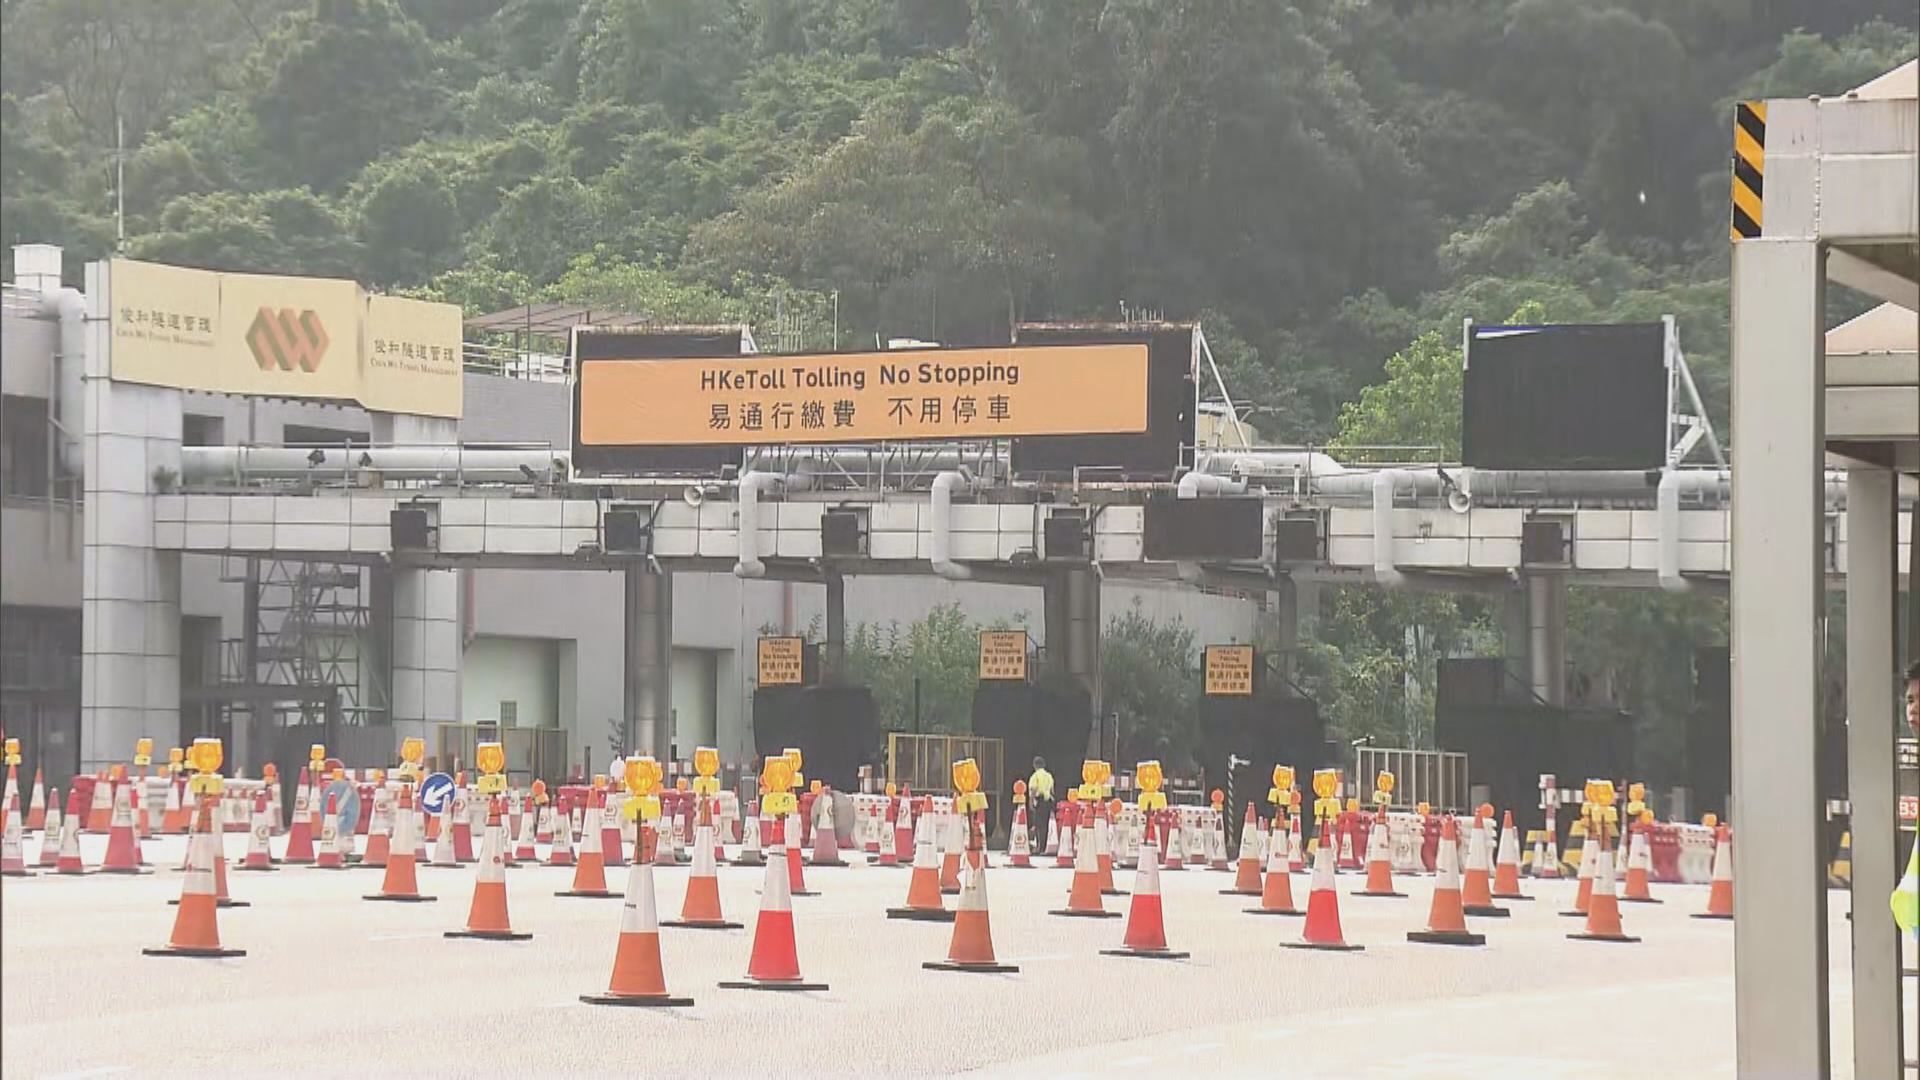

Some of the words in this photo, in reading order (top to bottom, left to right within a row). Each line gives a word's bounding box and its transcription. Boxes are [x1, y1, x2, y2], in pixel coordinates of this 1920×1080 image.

[701, 368, 786, 390] HKeToll
[792, 366, 866, 391] Tolling
[880, 364, 911, 384] No
[918, 360, 1019, 387] Stopping
[709, 399, 856, 431] 易通行繳費
[887, 394, 1011, 425] 不用停車
